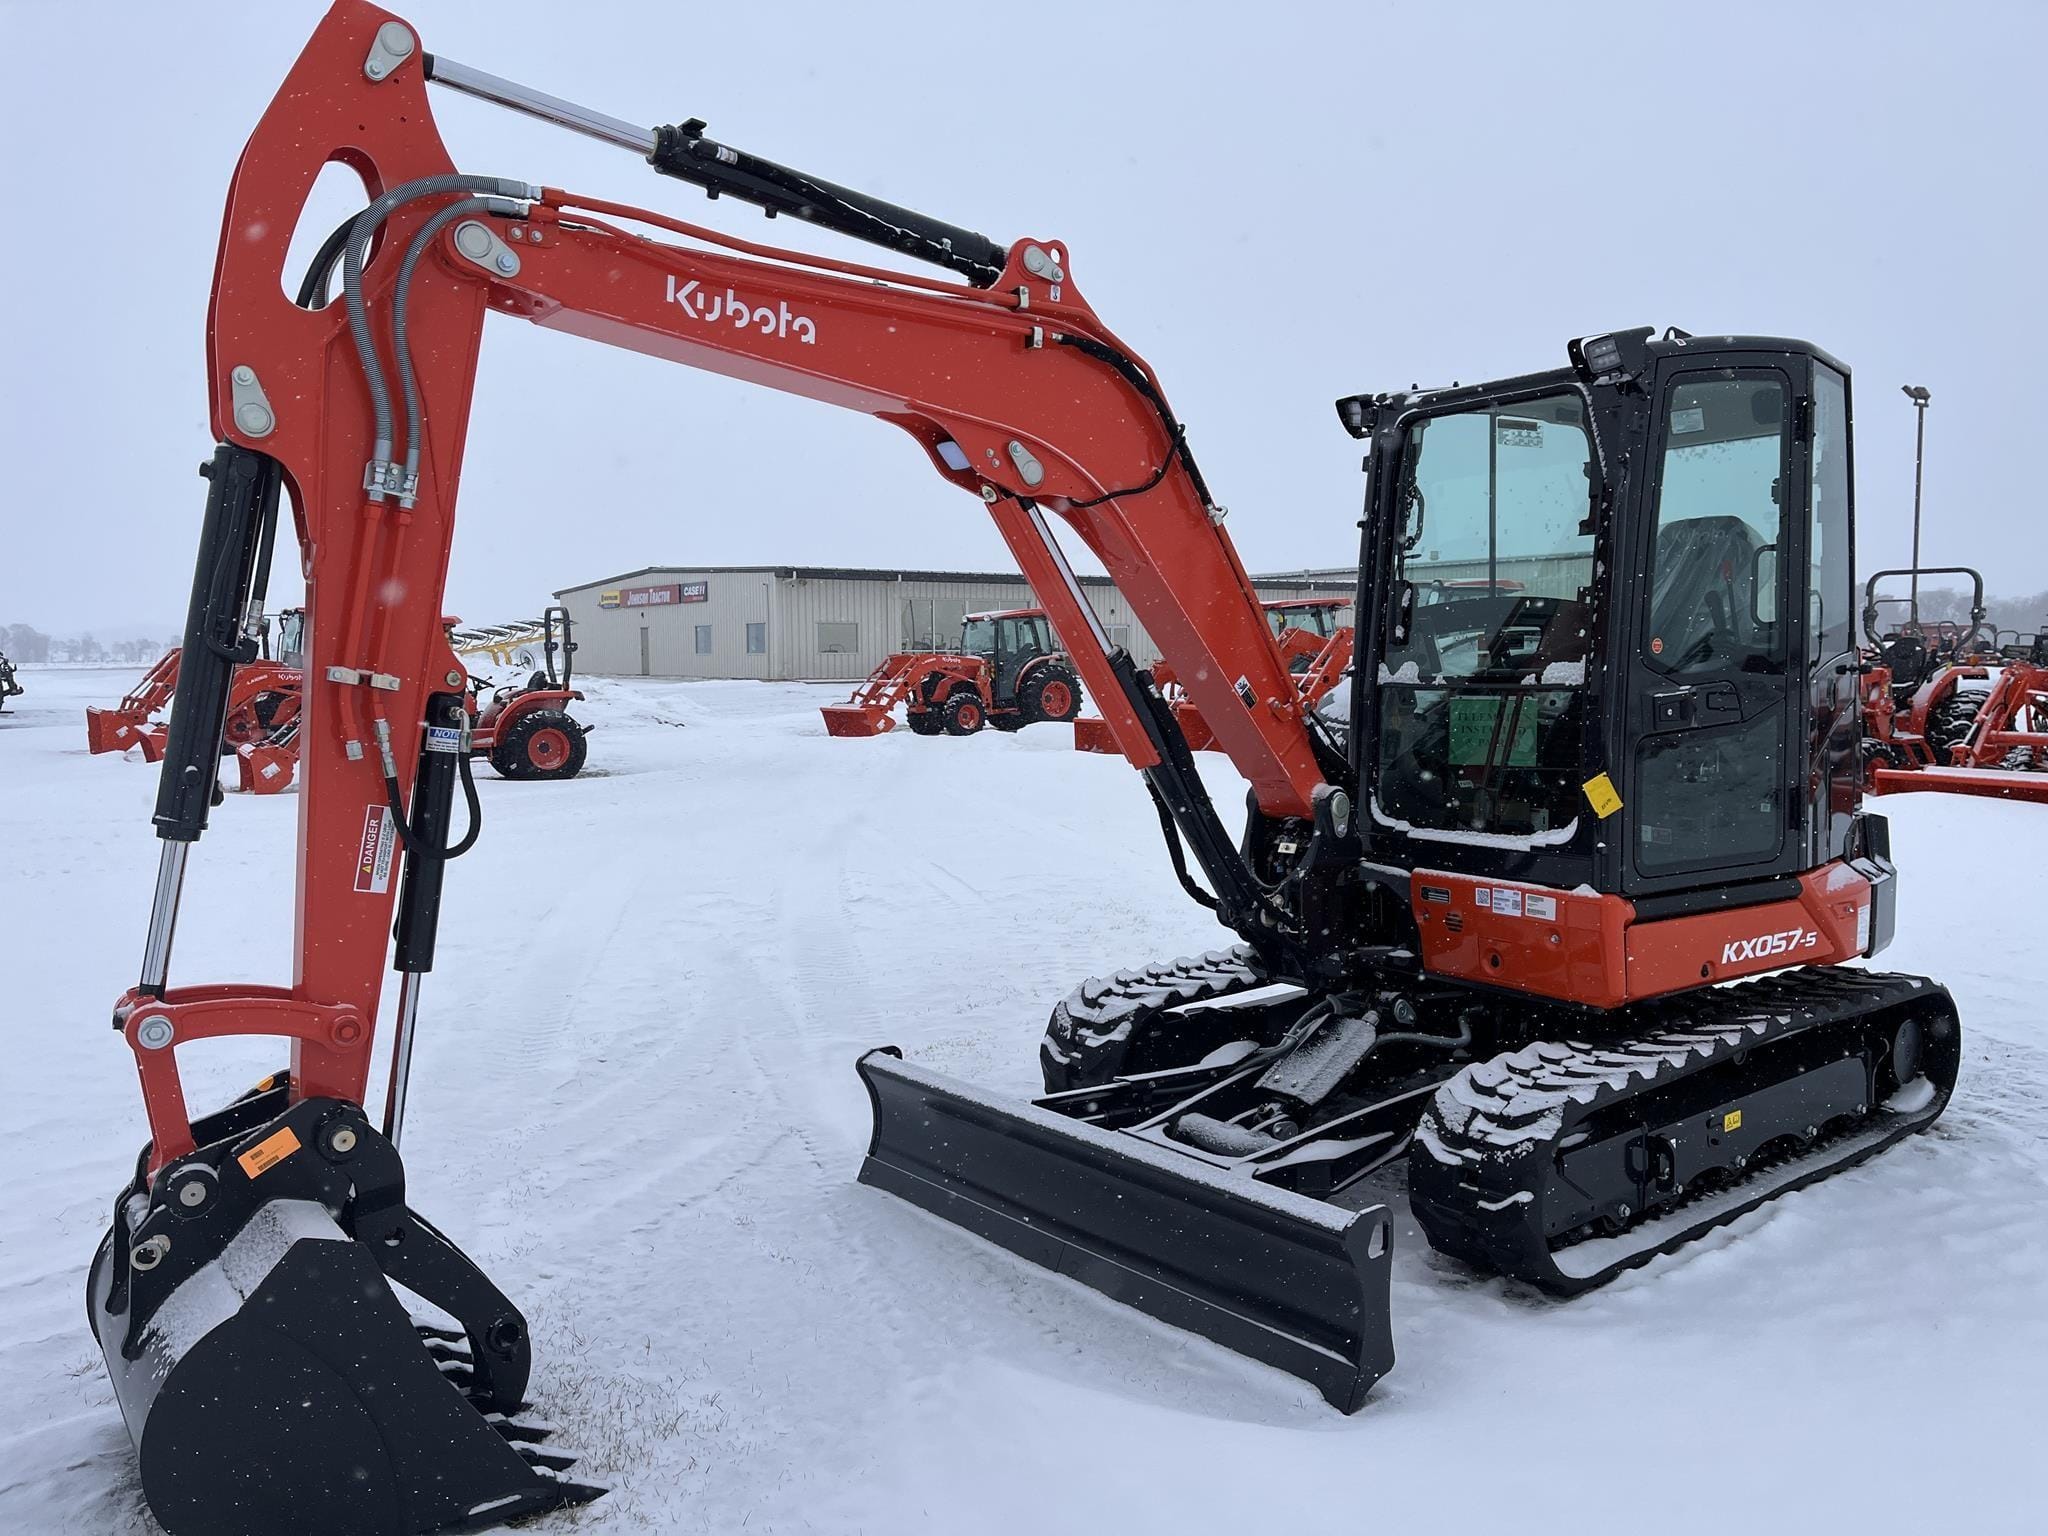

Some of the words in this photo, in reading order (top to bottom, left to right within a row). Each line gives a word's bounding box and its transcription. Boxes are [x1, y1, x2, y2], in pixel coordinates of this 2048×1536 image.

[667, 274, 816, 345] Kubota
[683, 586, 700, 596] CASE
[278, 673, 302, 681] Kubot
[363, 819, 379, 864] DANGER
[1721, 927, 1818, 964] KX057-5
